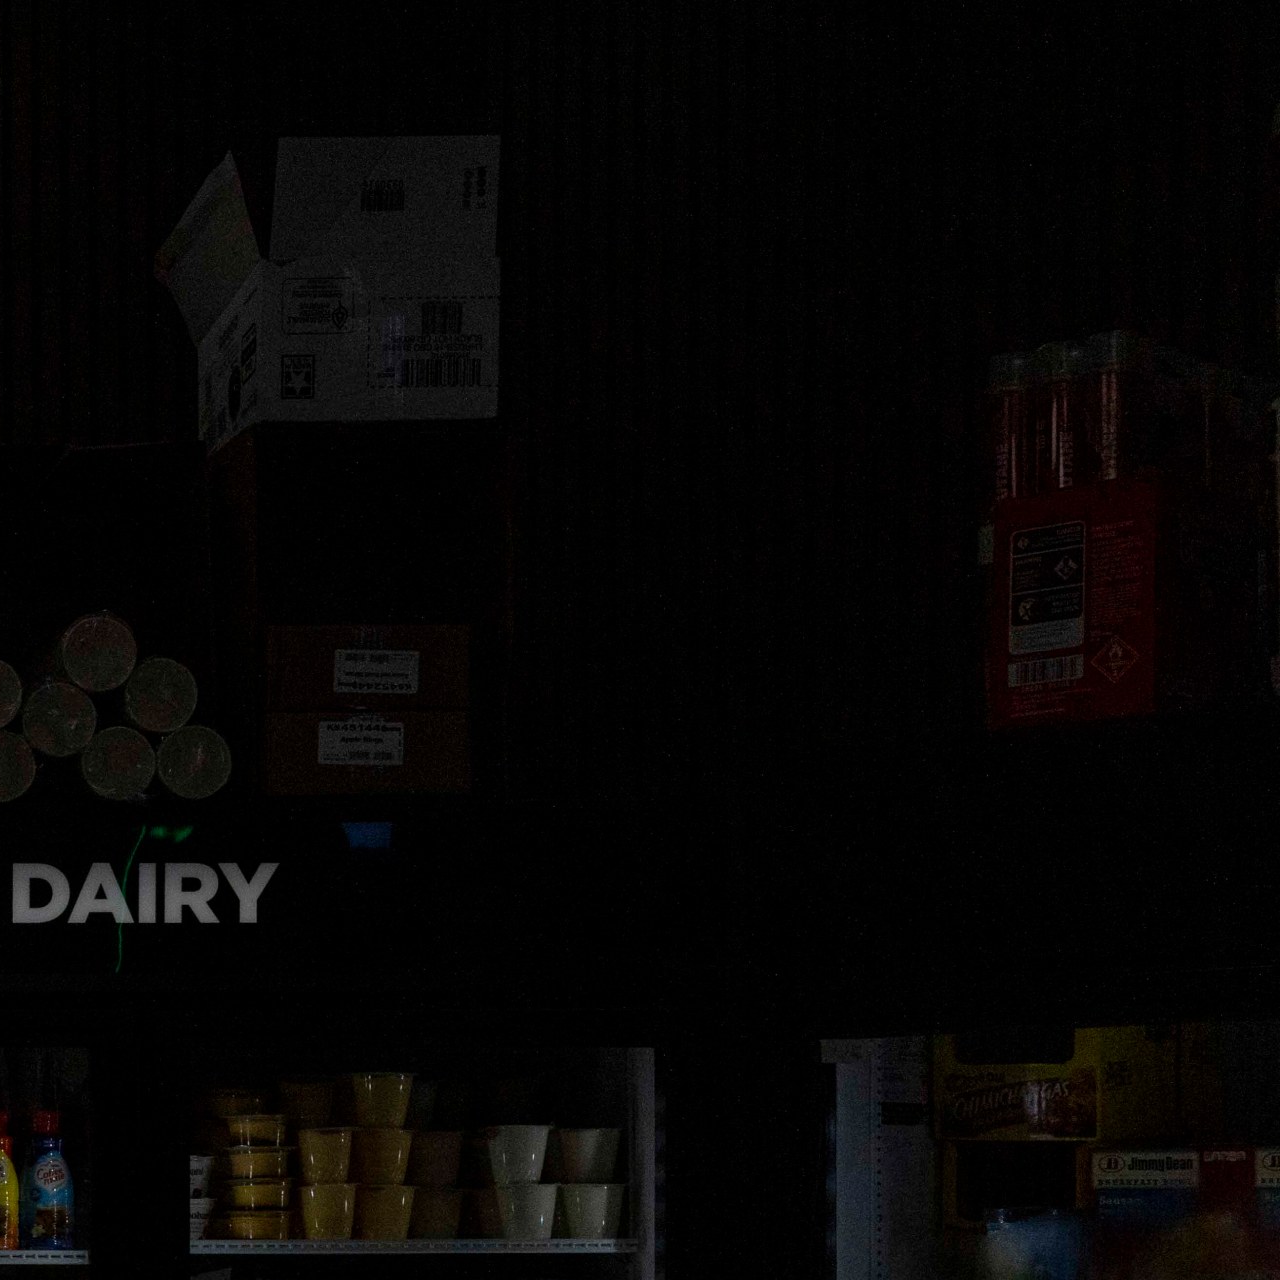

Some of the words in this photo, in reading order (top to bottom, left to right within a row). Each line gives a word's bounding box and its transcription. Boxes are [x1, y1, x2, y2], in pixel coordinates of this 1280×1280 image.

[12, 862, 280, 923] DAIRY
[955, 1080, 1070, 1118] CHIMICHGAS
[1127, 1157, 1164, 1172] Jimmy
[1165, 1156, 1193, 1171] Dean
